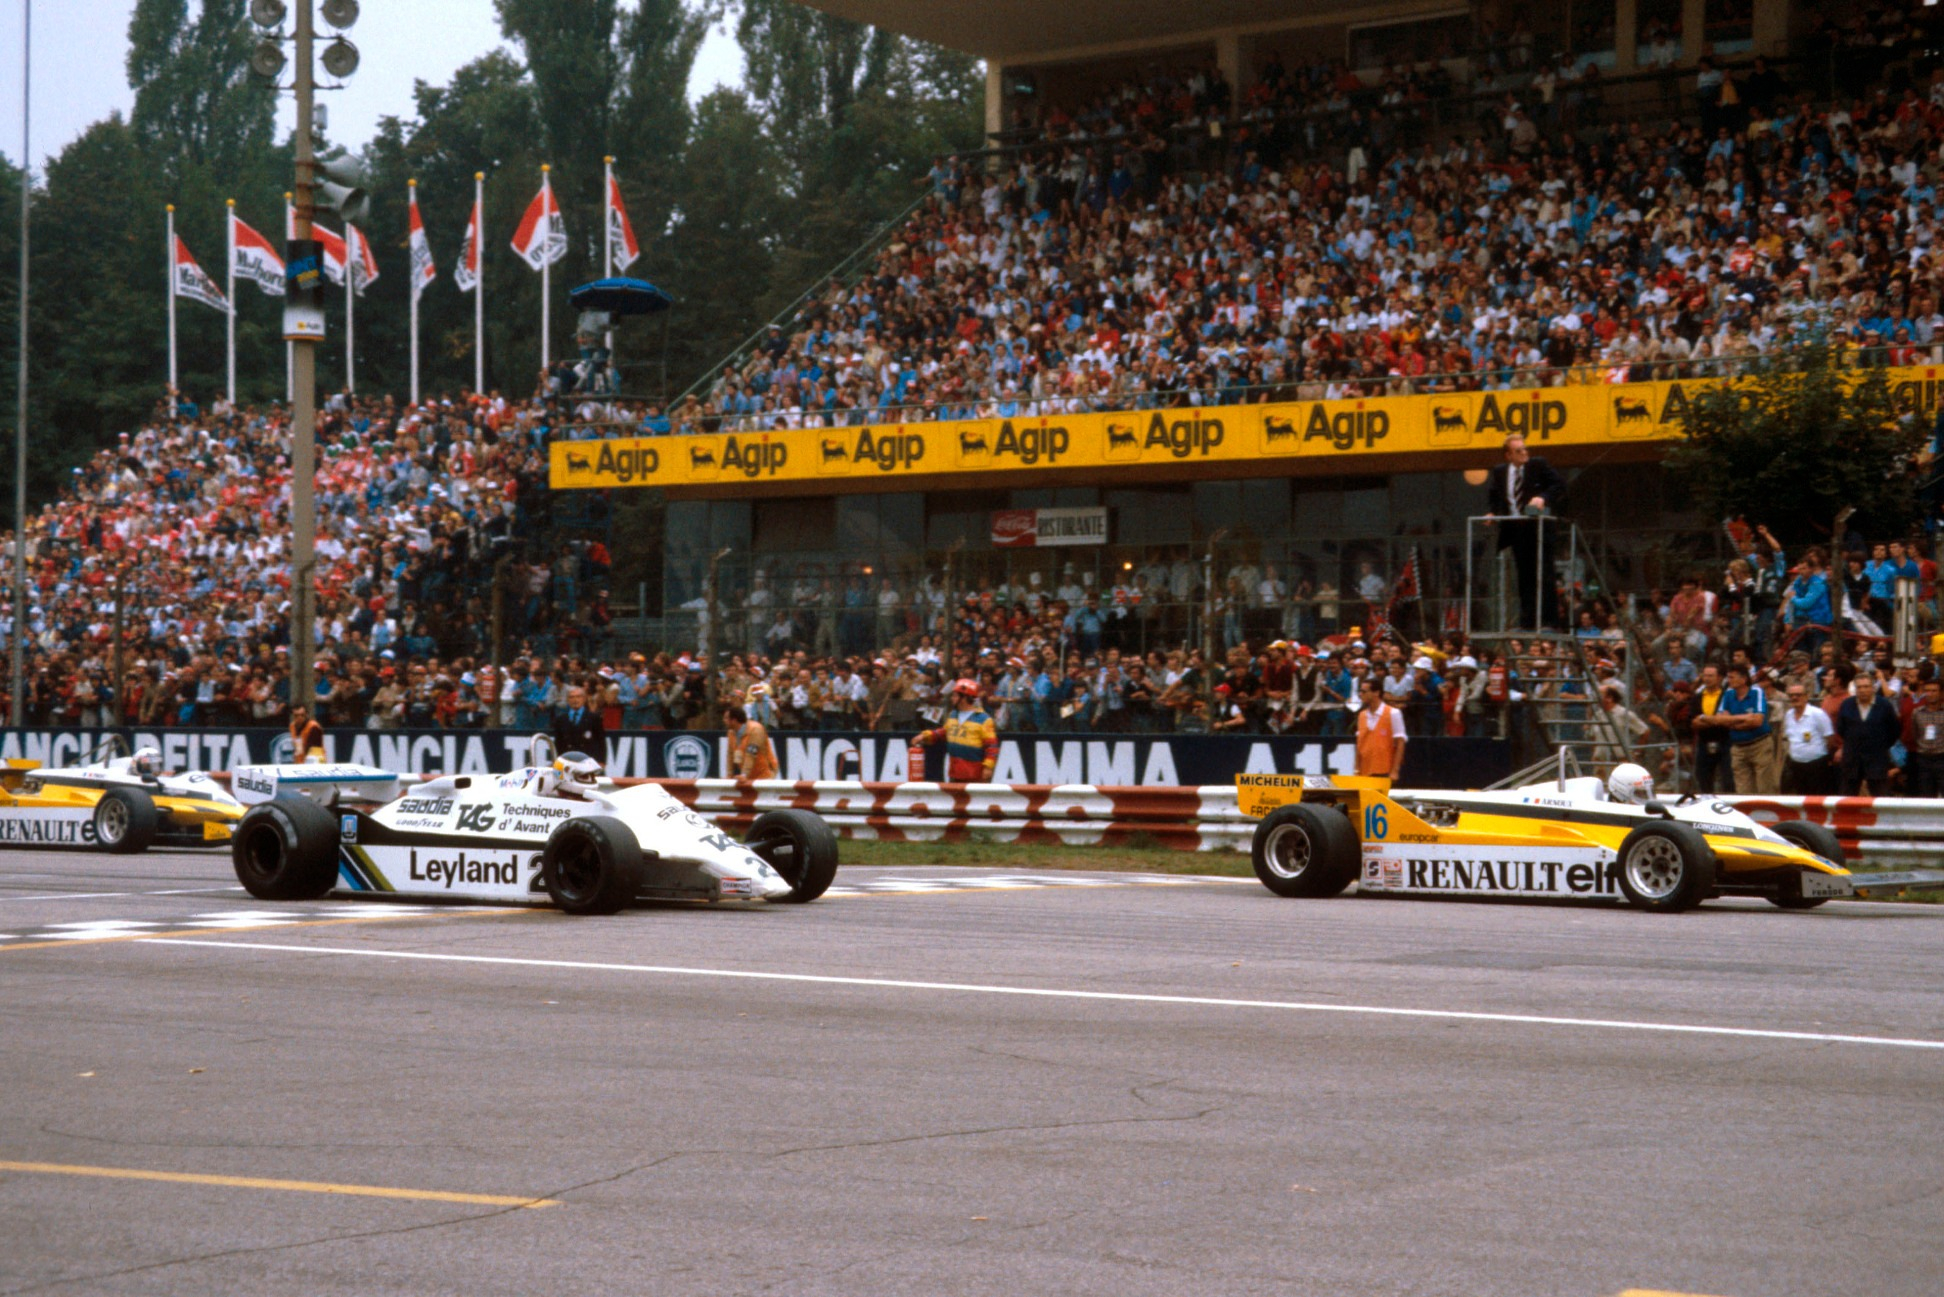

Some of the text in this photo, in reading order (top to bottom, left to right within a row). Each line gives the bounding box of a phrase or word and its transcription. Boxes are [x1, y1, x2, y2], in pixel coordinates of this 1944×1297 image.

[1144, 409, 1225, 459] Agip
[1303, 401, 1391, 450] Agip
[1474, 391, 1568, 440] Agip
[721, 433, 788, 478] Agip
[853, 425, 926, 471] Agip
[993, 417, 1070, 465] Agip
[596, 441, 659, 483] Agip
[719, 737, 1180, 787] LNCIA AMMA
[238, 776, 273, 796] saudia
[1240, 775, 1301, 789] MICHELIN
[397, 796, 454, 815] saudia
[455, 801, 496, 832] TAG
[503, 803, 571, 818] Techniques
[1364, 803, 1388, 840] 16
[1400, 832, 1440, 843] europcar
[410, 850, 518, 889] Leyland
[1406, 858, 1563, 892] RENAULT
